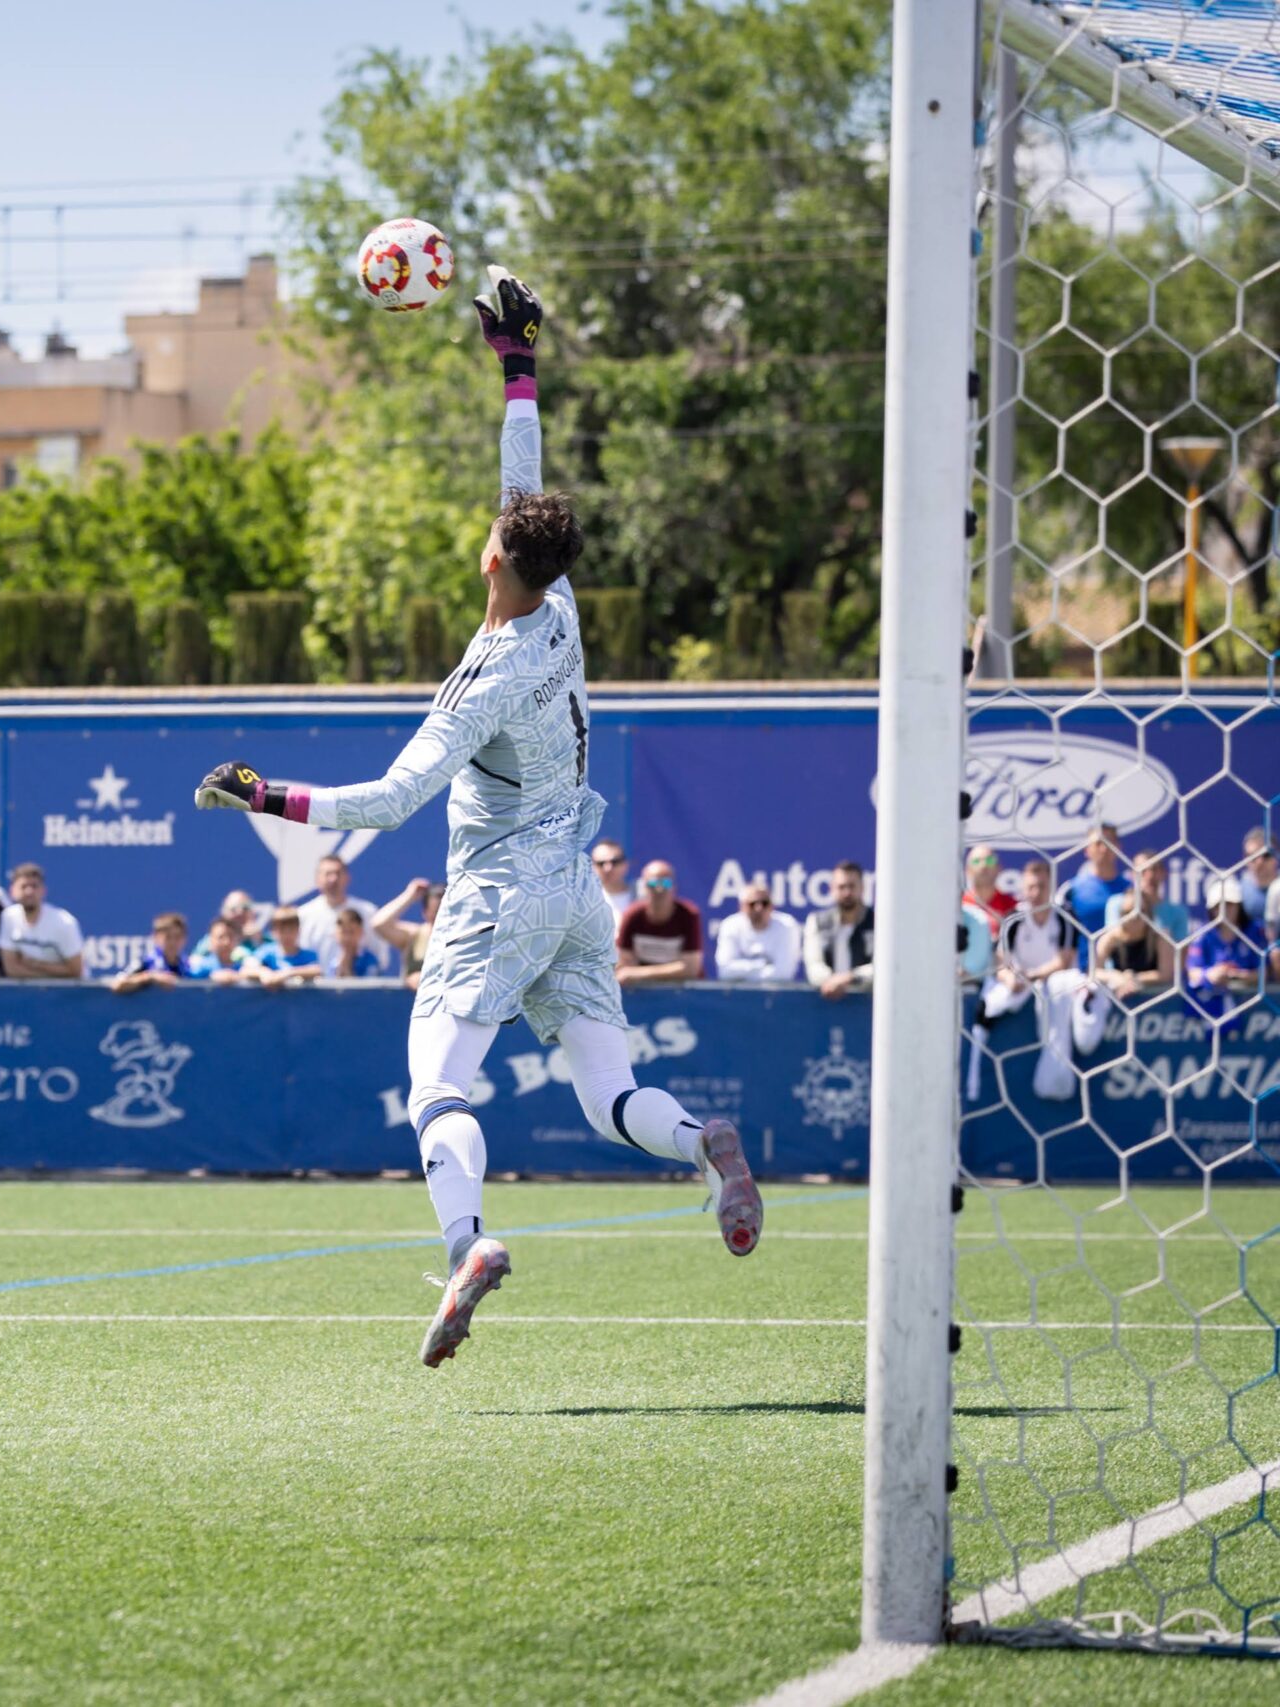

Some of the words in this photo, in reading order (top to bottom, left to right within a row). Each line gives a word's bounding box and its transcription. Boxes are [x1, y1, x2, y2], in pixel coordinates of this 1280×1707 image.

[533, 643, 582, 710] RODRIGUE
[965, 755, 1107, 821] Ford
[43, 813, 173, 846] Heineken
